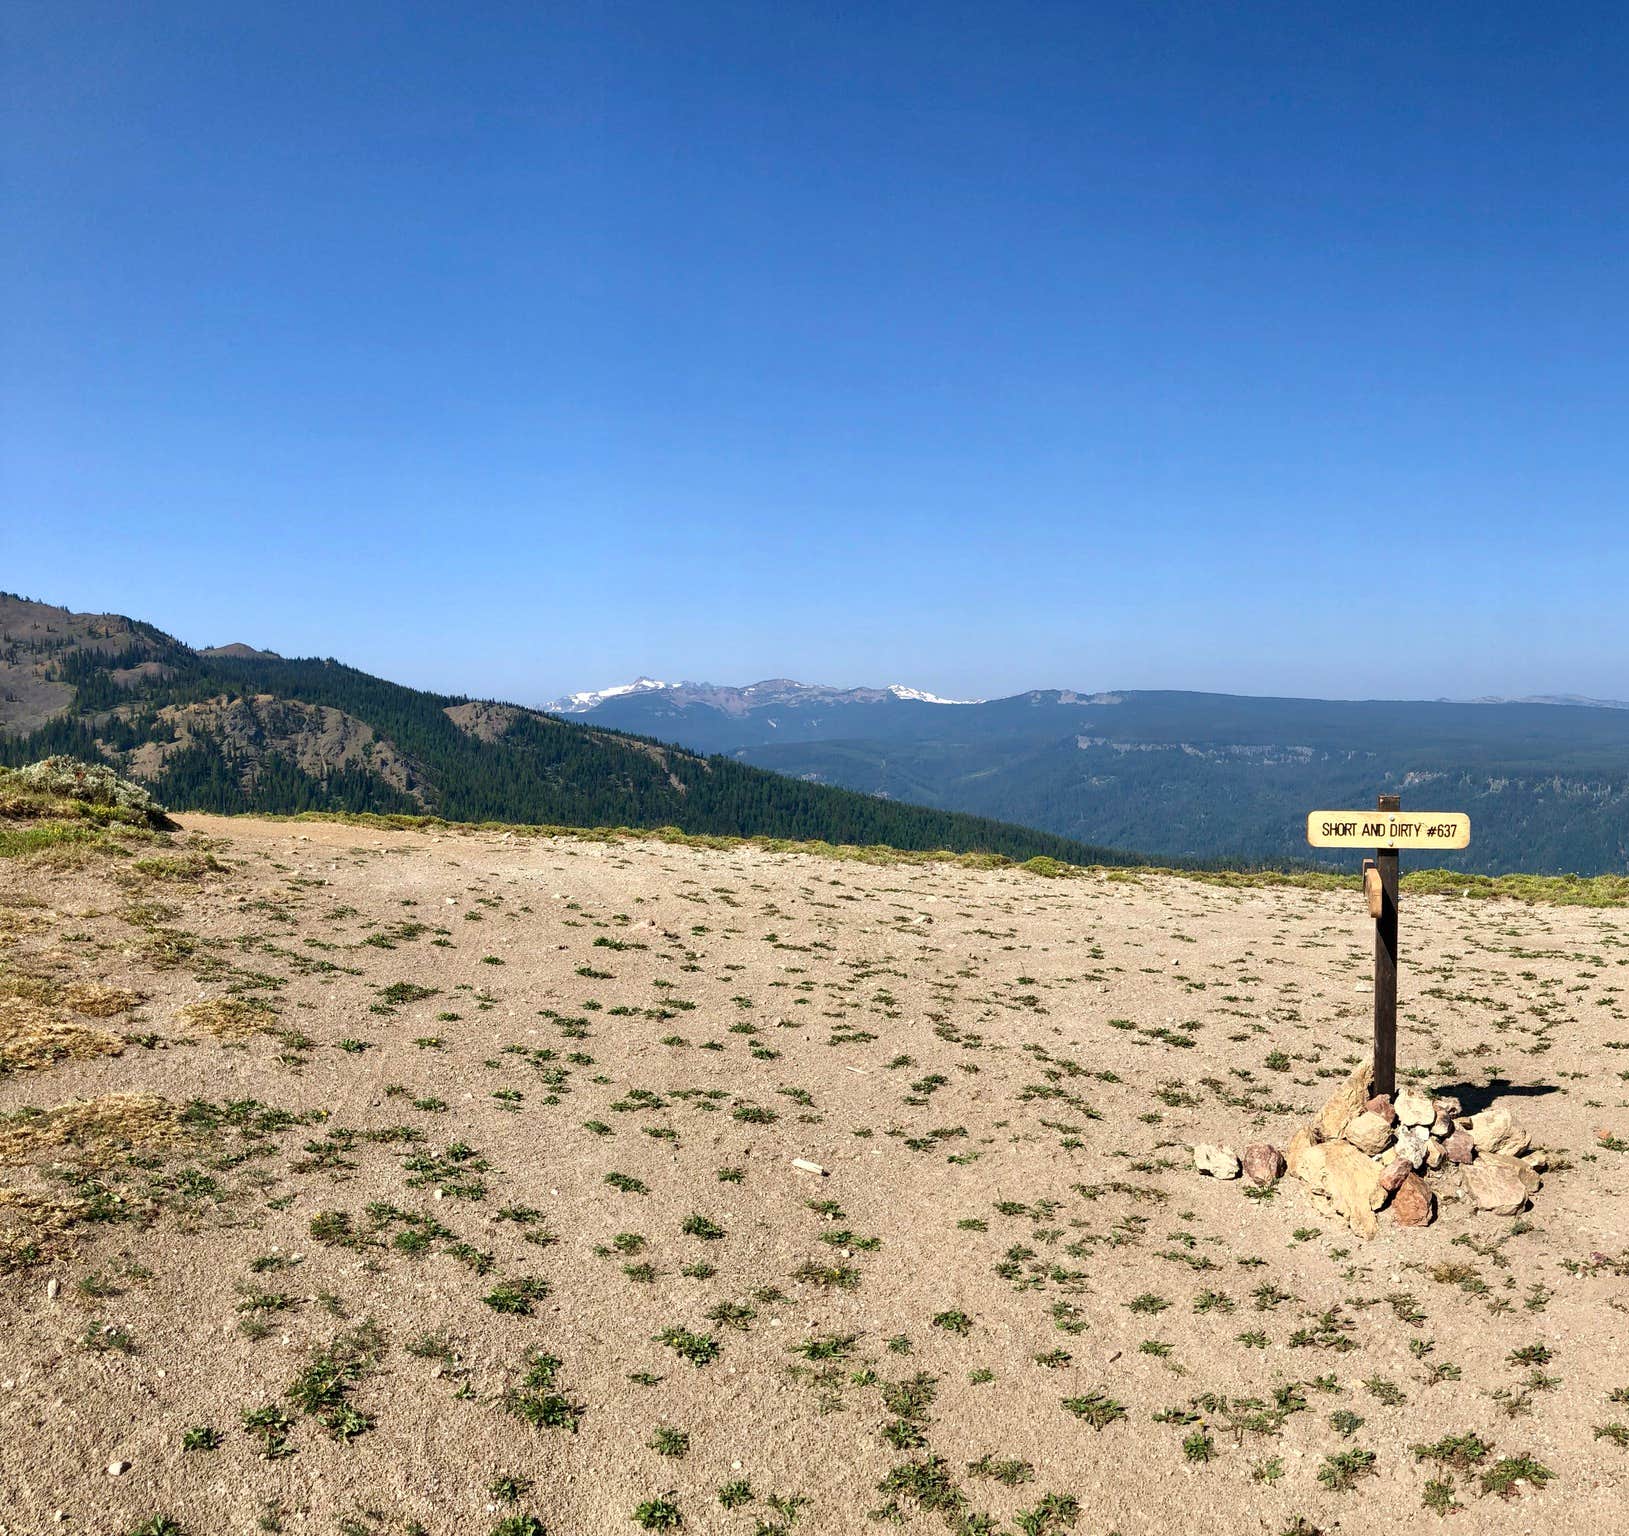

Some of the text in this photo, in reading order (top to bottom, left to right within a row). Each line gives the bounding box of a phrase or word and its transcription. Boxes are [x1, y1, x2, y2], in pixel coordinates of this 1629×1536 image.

[1322, 823, 1457, 838] SHORT AND DIRTY #637
